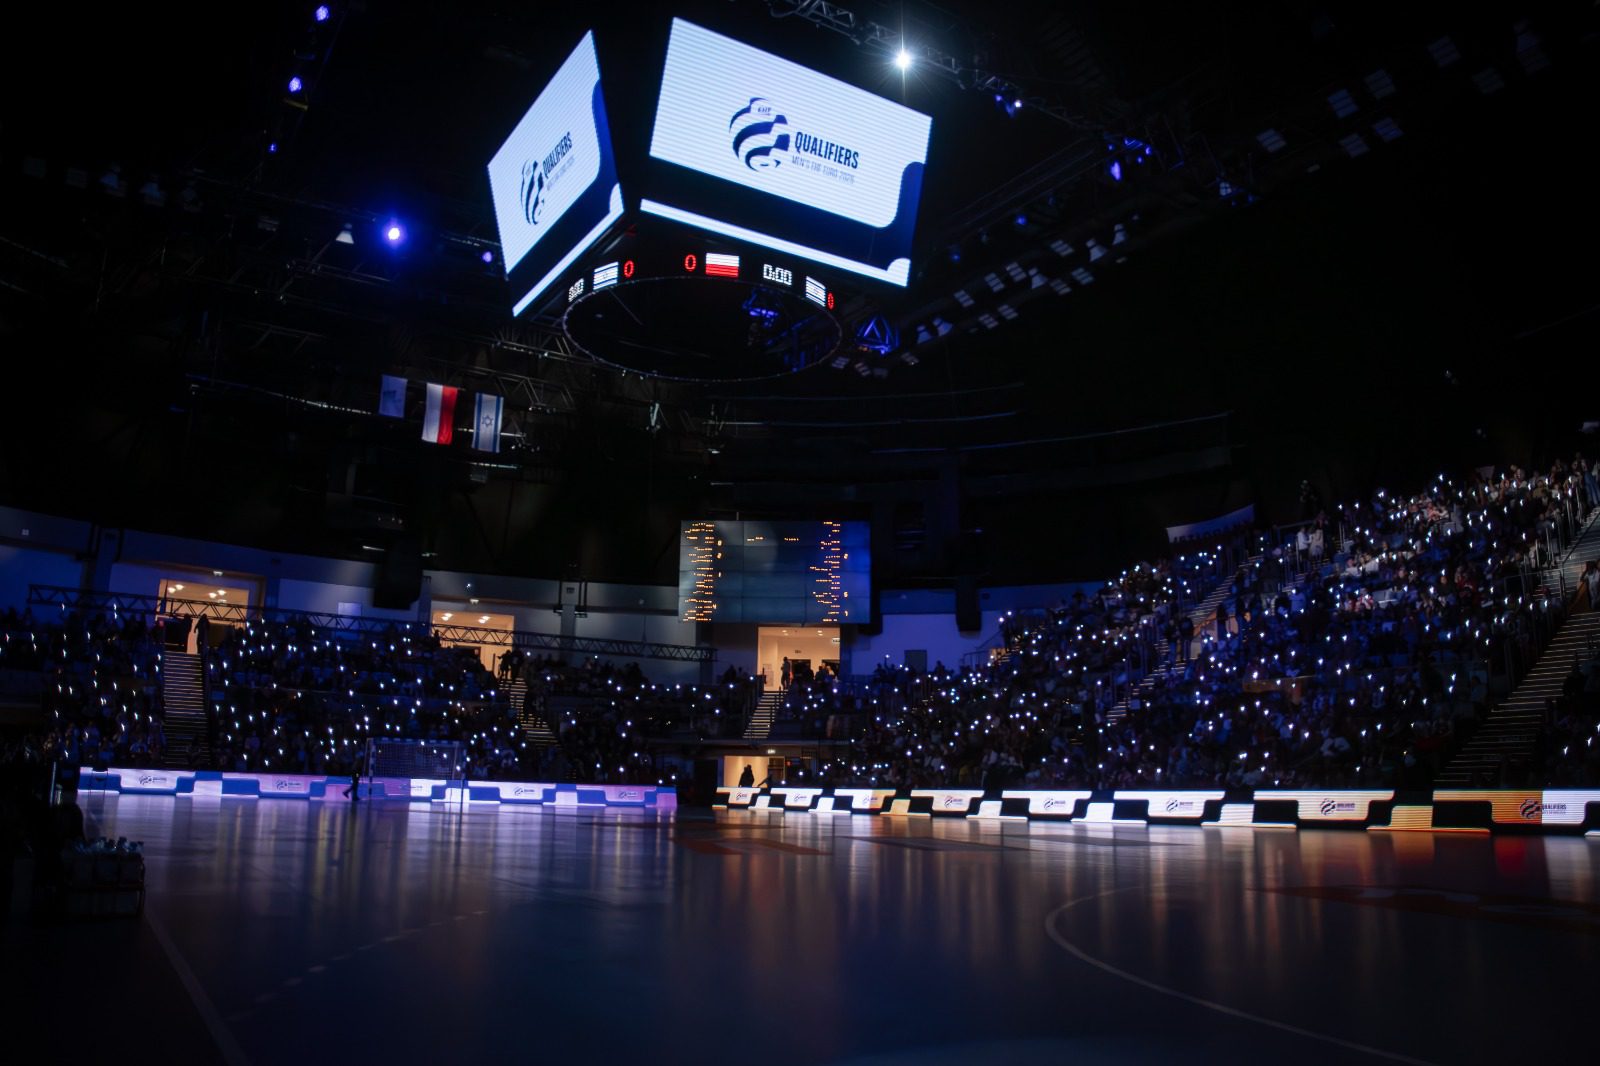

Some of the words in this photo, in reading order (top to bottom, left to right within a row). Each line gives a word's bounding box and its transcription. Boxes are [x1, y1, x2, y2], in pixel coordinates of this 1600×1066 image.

[542, 131, 573, 179] QUALIFIERS
[795, 132, 860, 169] QUALIFIERS
[623, 260, 634, 278] 0
[684, 254, 697, 272] 0
[763, 263, 793, 286] 0:00
